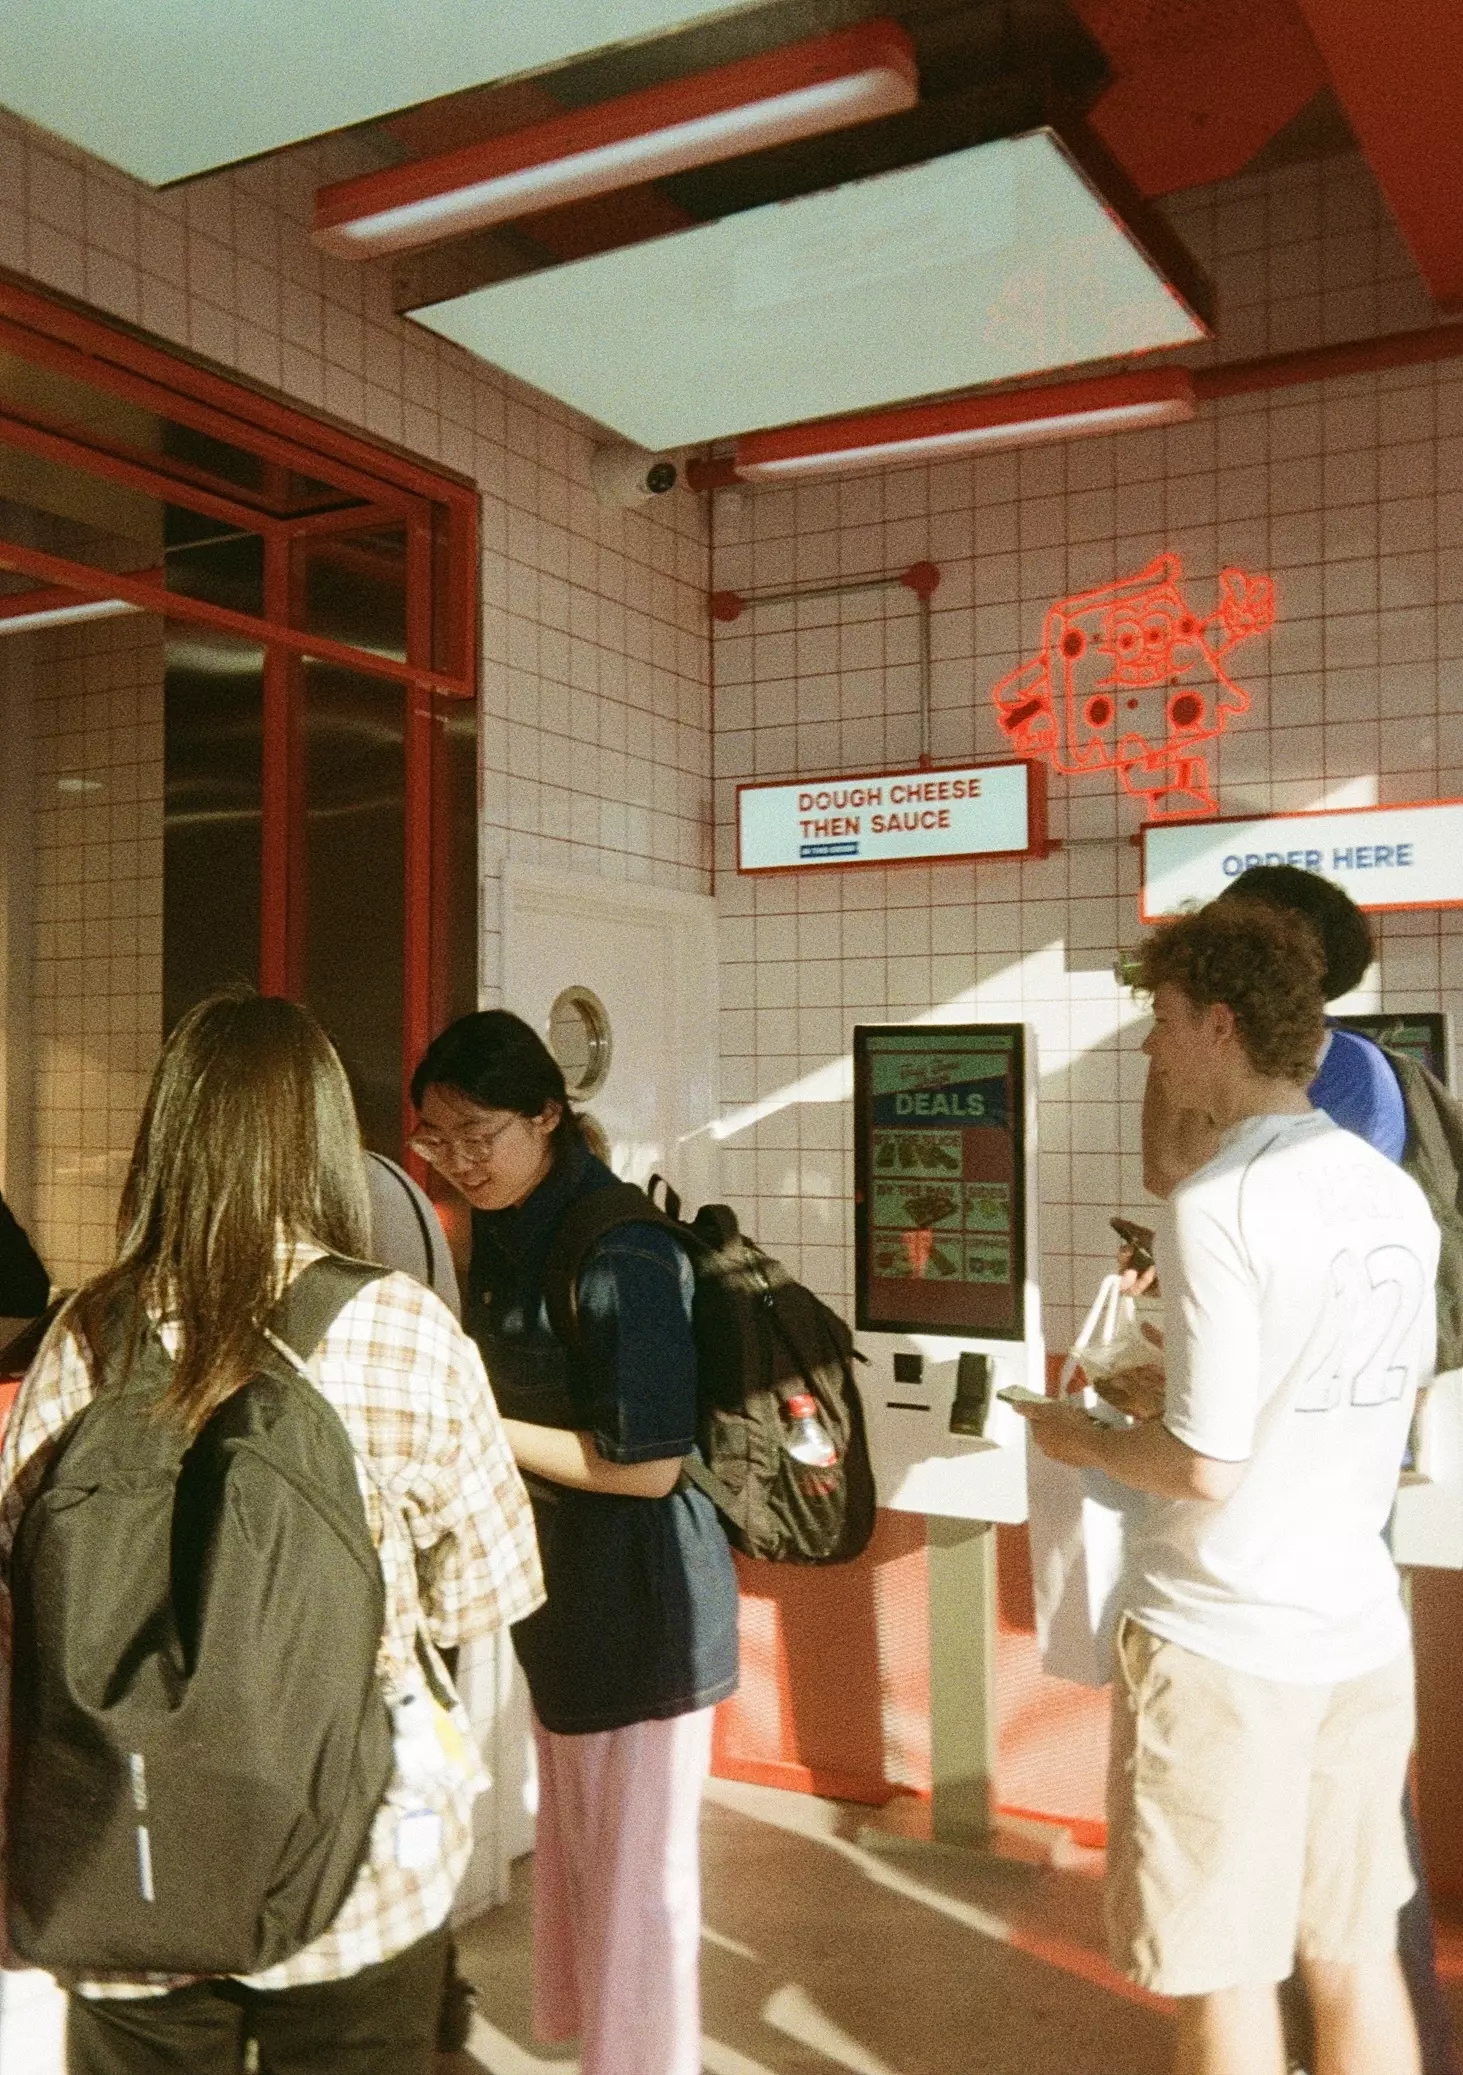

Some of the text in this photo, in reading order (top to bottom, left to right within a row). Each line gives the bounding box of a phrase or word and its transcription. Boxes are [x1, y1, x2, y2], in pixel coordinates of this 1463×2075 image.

[799, 779, 981, 811] DOUGH CHEESE
[800, 809, 950, 838] THEN SAUCE
[1332, 843, 1413, 870] HERE
[896, 1093, 984, 1116] DEALS
